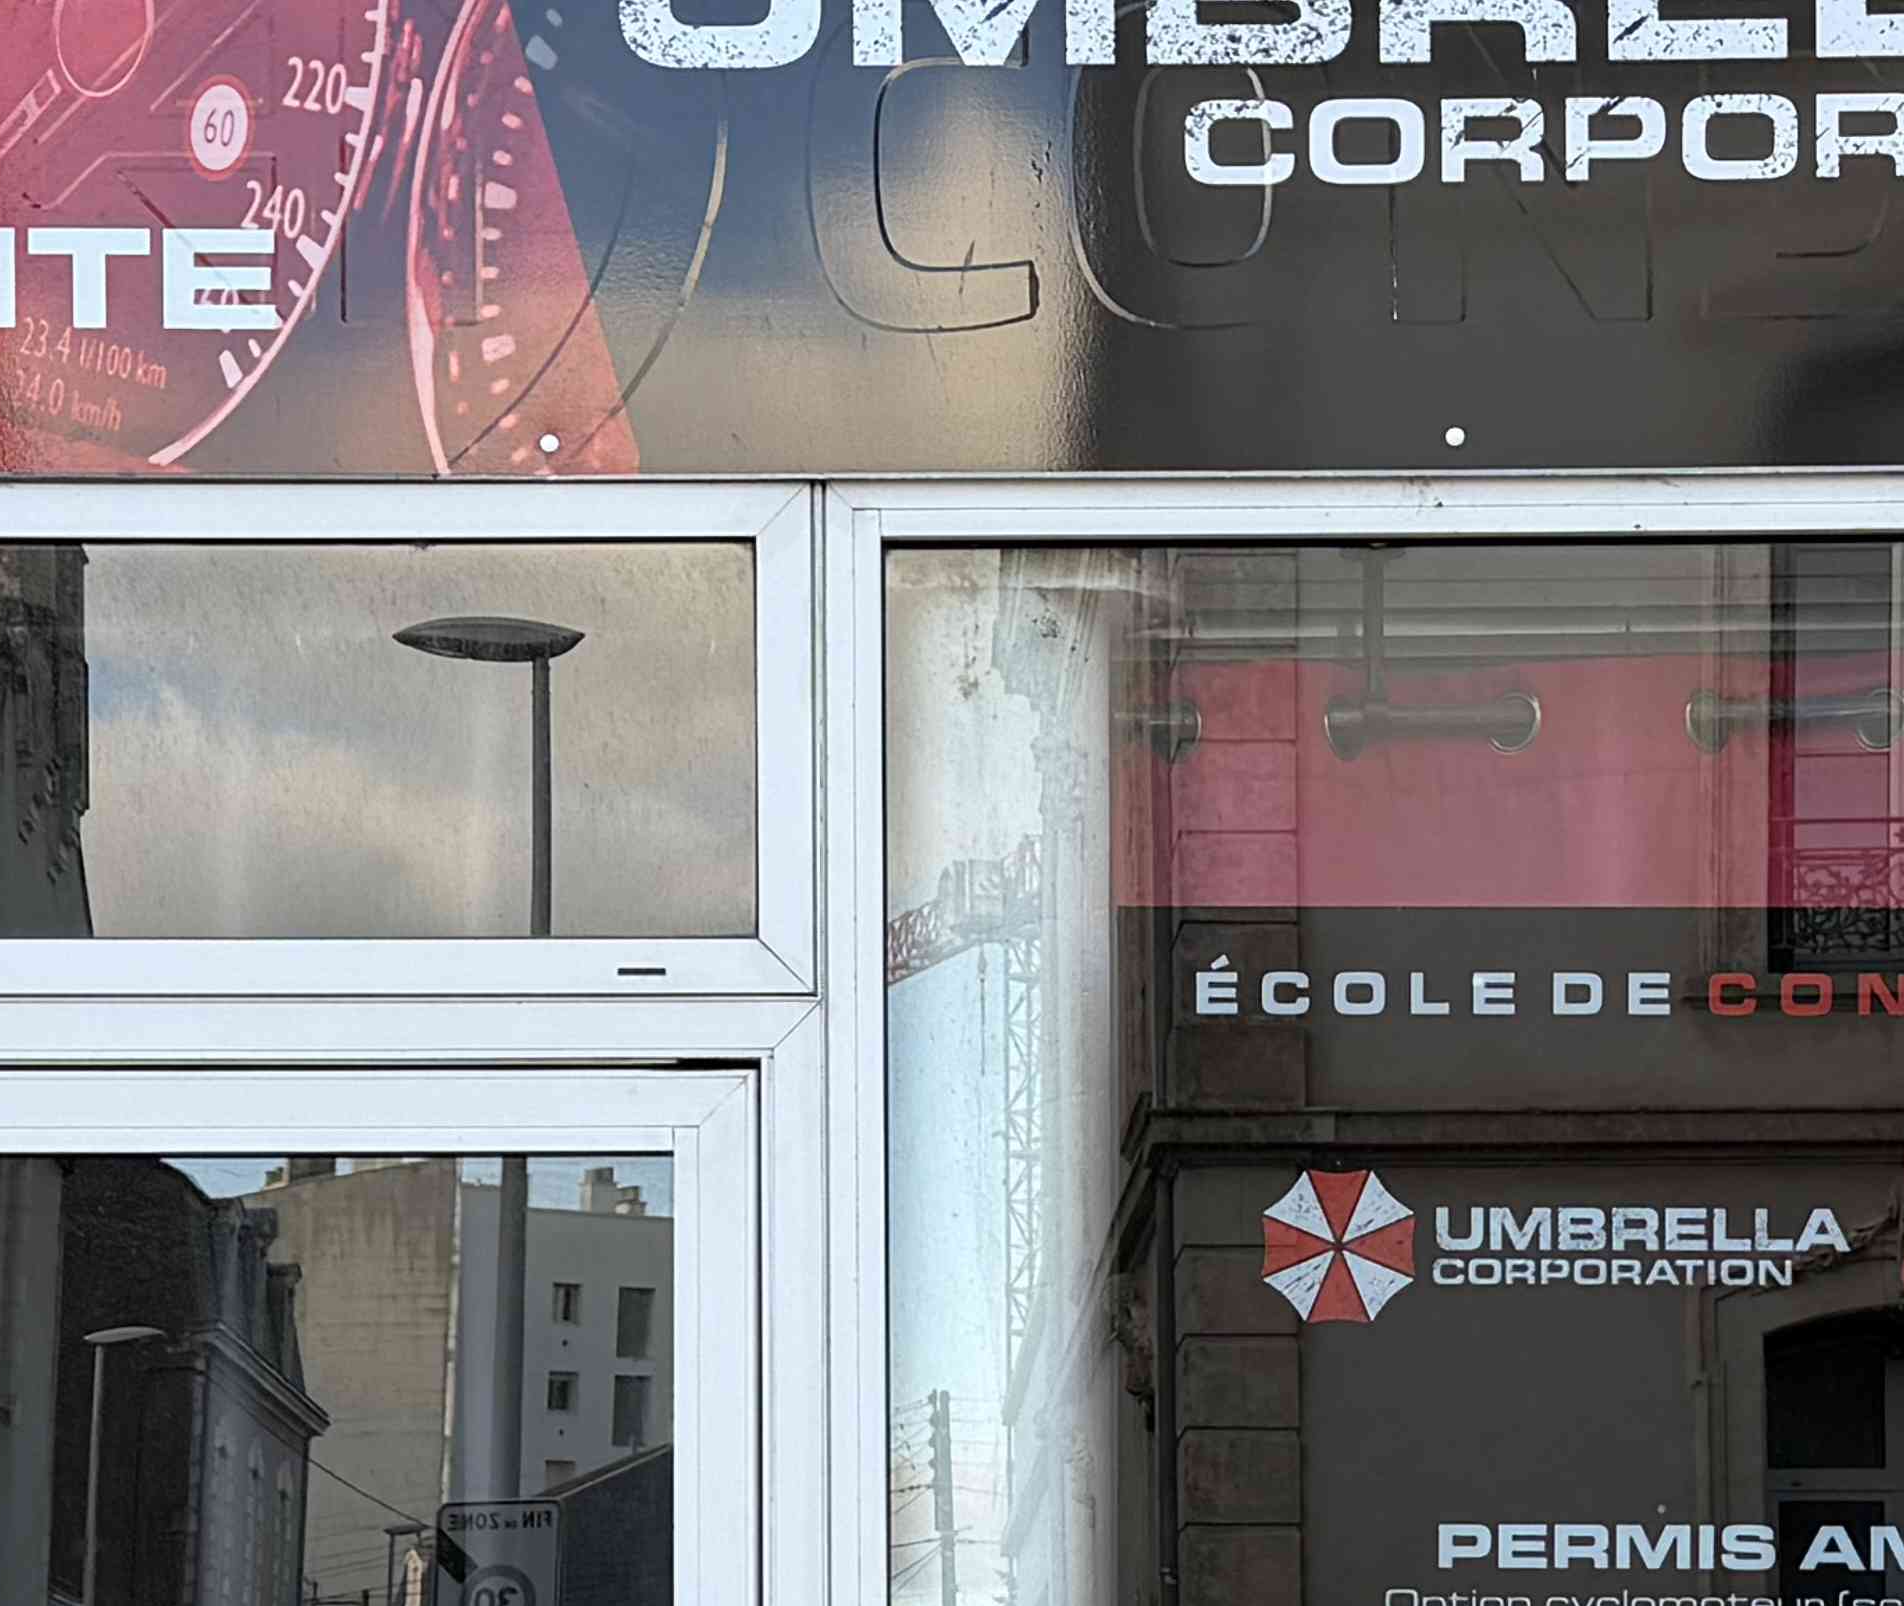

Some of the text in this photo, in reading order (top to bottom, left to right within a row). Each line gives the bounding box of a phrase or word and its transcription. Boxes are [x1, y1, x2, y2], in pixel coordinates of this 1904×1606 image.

[283, 56, 348, 114] 220
[203, 107, 235, 147] 60
[240, 180, 305, 238] 240
[18, 318, 71, 359] 23.4
[1195, 954, 1516, 1017] ÉCOLE
[1554, 972, 1673, 1017] DE
[1434, 1206, 1852, 1254] UMBRELLA
[1432, 1258, 1794, 1288] CORPORATION
[1436, 1523, 1779, 1572] PERMIS
